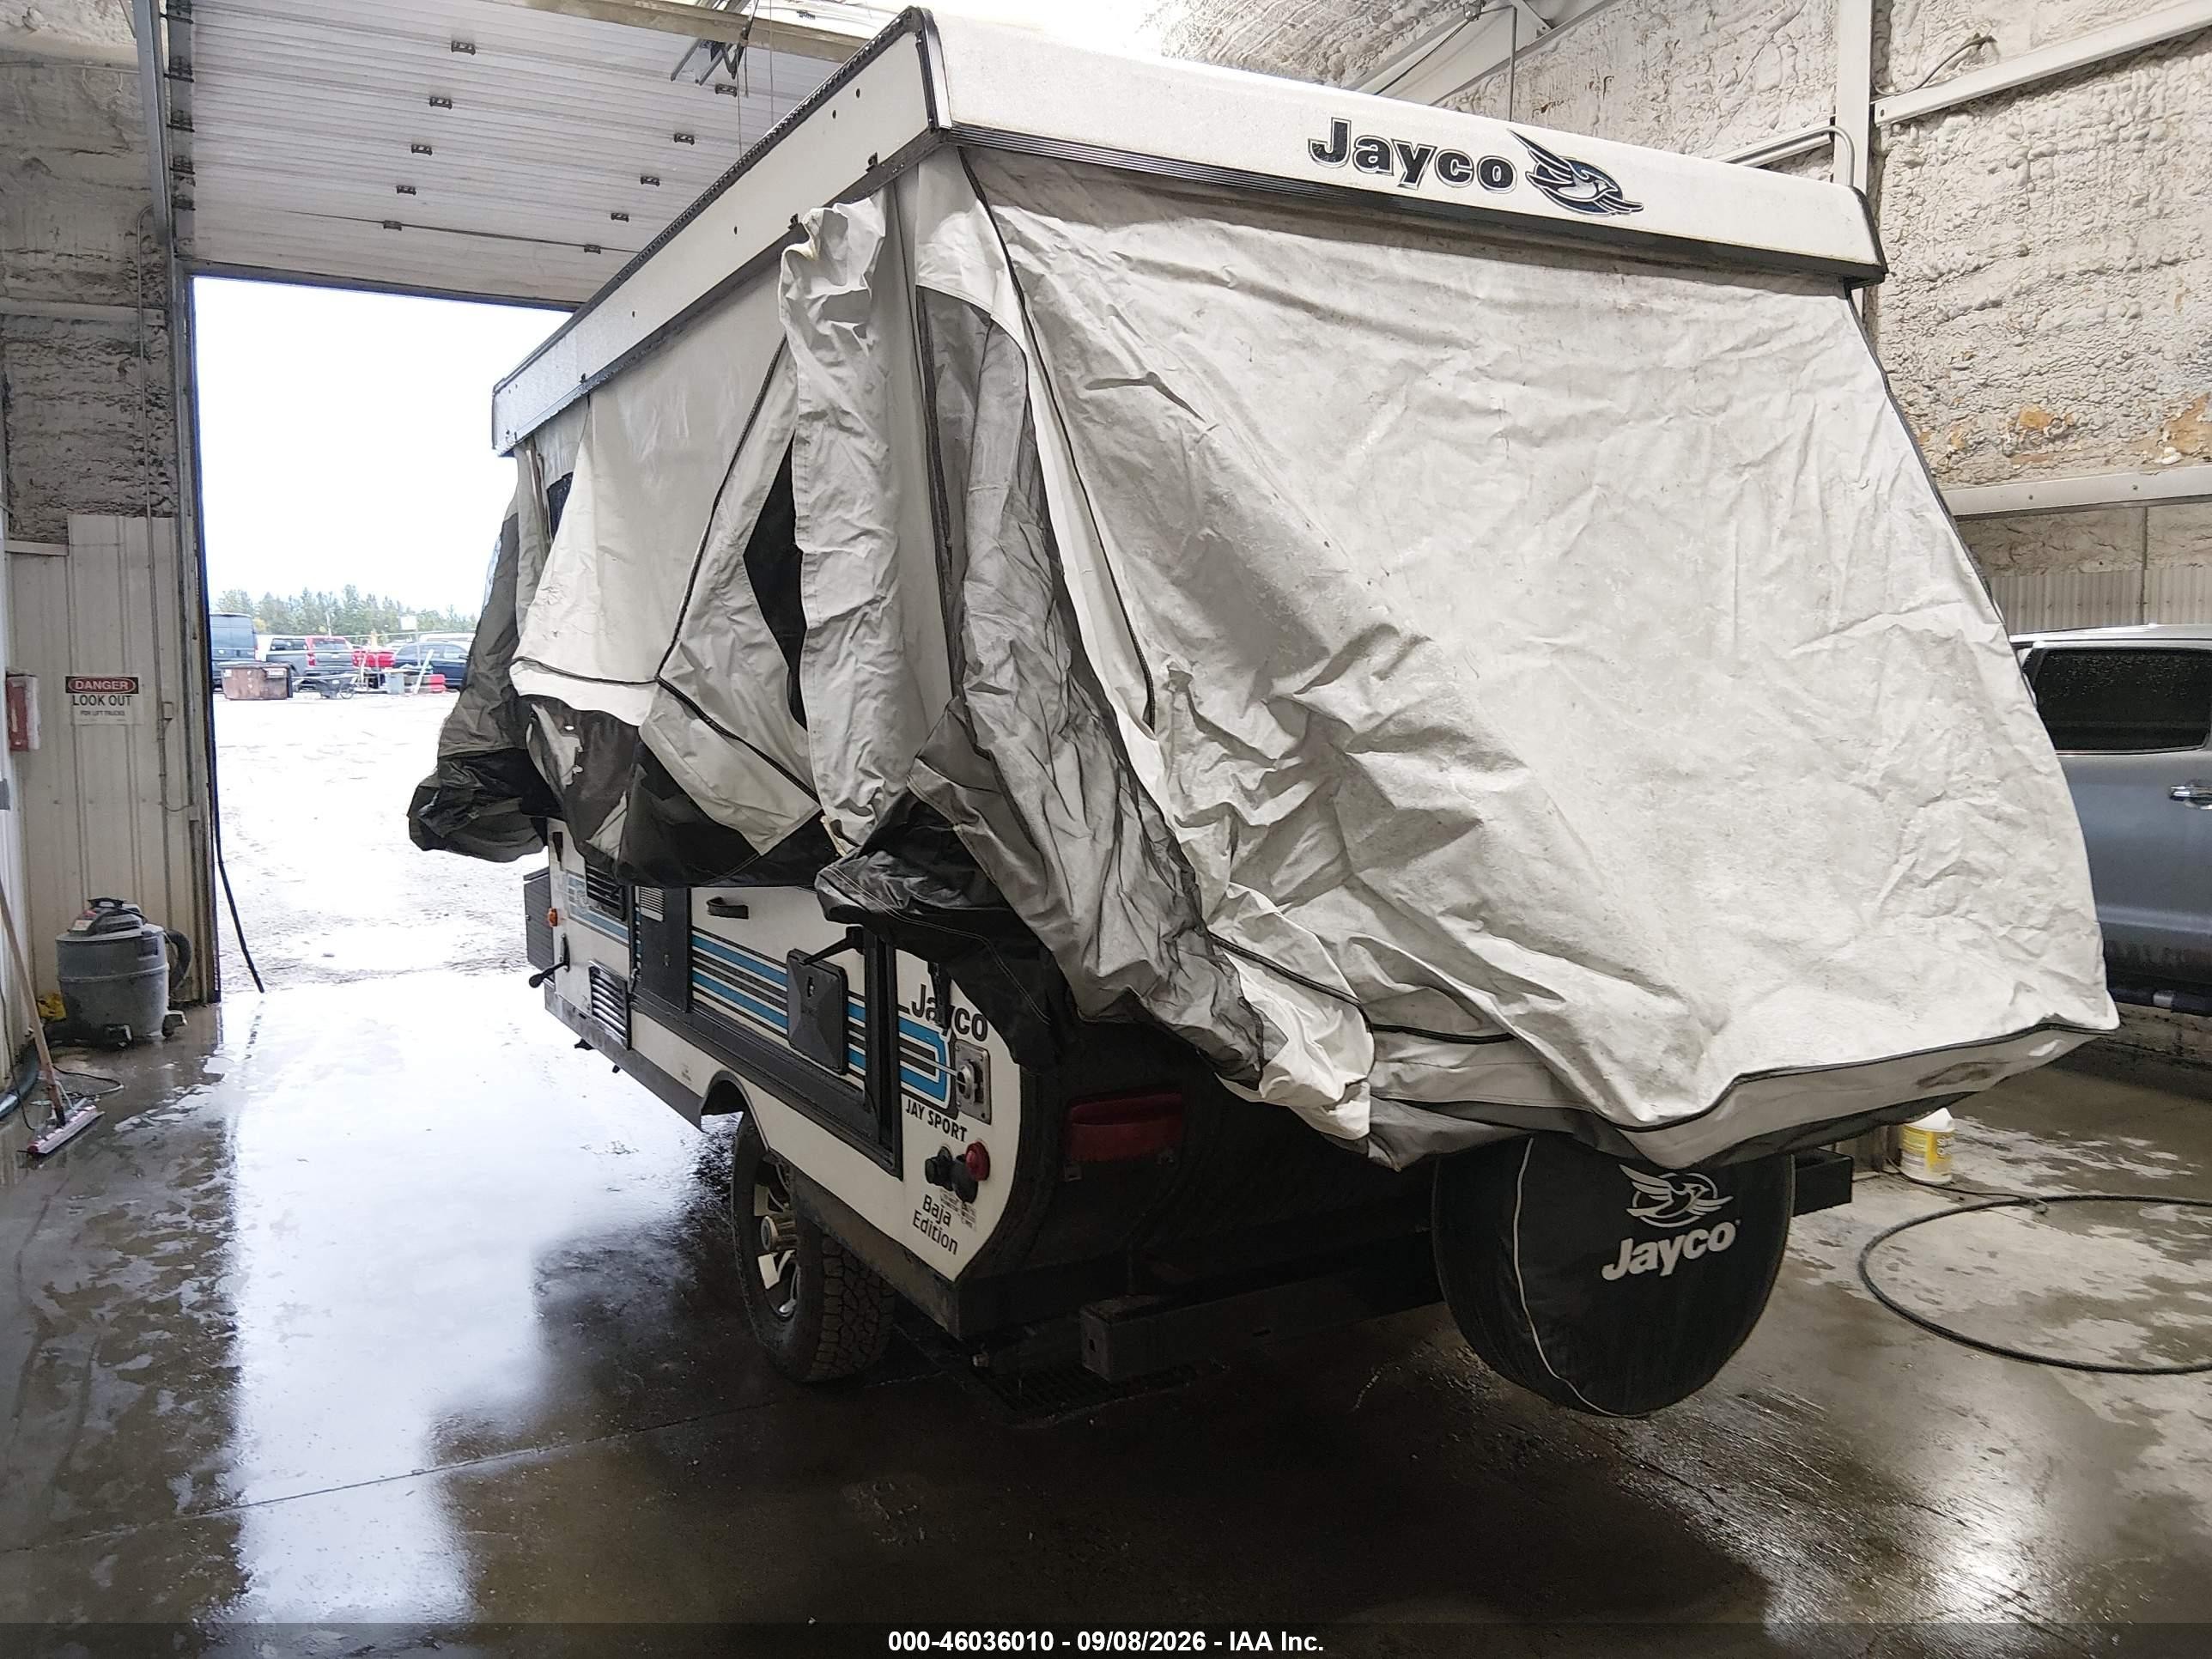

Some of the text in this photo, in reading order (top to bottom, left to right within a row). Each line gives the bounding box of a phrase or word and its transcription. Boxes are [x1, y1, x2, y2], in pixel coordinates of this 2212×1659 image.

[1308, 117, 1518, 193] Jayco
[72, 695, 132, 706] LOOK OUT
[75, 680, 129, 690] DANGER
[906, 1099, 968, 1142] JAY SPORT
[912, 1209, 958, 1255] Edition
[923, 1194, 951, 1227] Baja
[1601, 1222, 1736, 1280] Jayco
